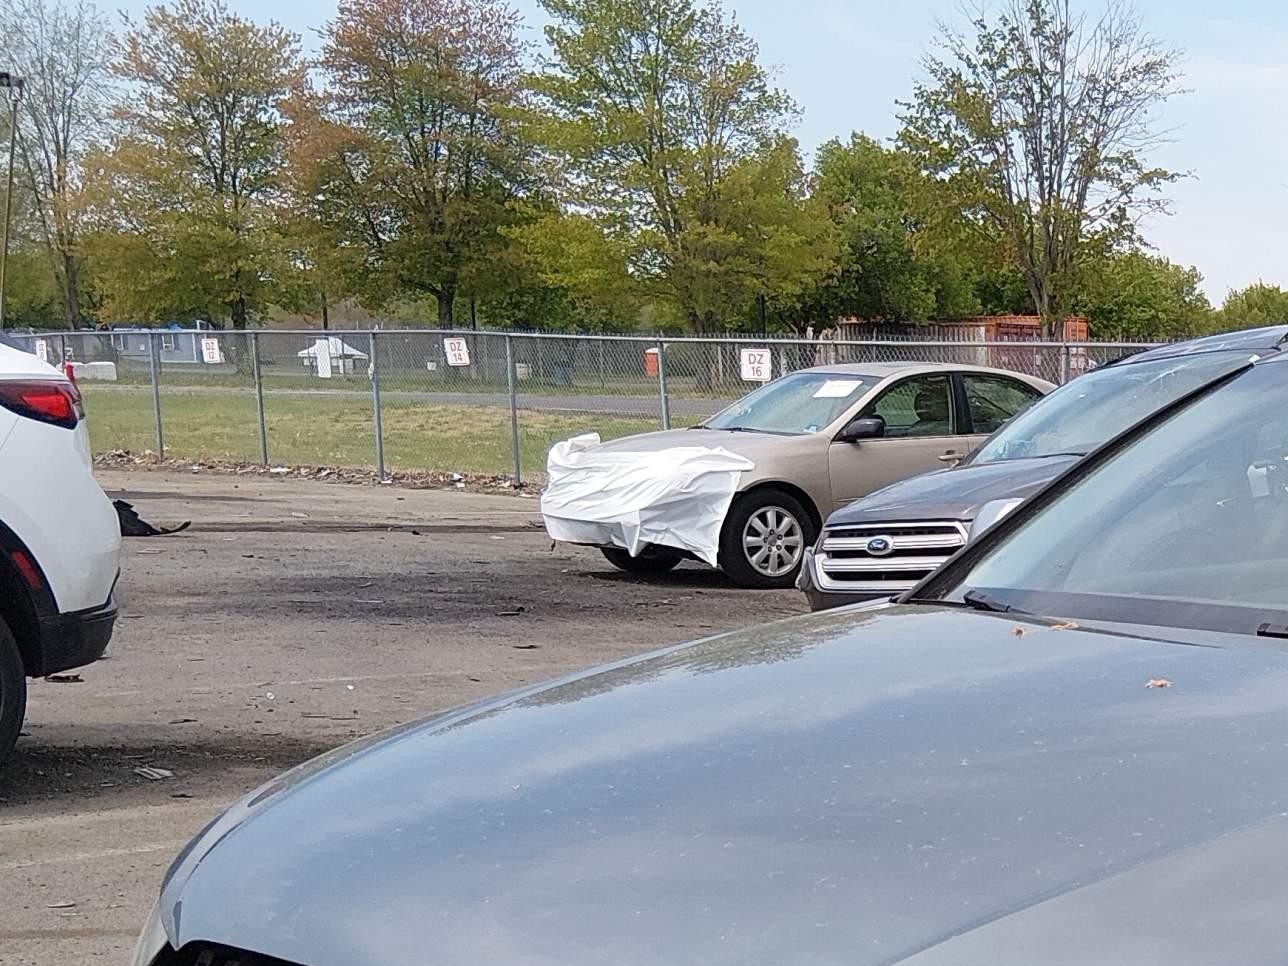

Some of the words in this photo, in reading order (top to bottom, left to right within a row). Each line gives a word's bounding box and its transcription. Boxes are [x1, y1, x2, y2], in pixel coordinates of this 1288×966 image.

[205, 342, 216, 351] DZ
[449, 342, 463, 352] DZ
[453, 352, 463, 362] 14
[748, 353, 765, 365] DZ
[751, 366, 763, 377] 16
